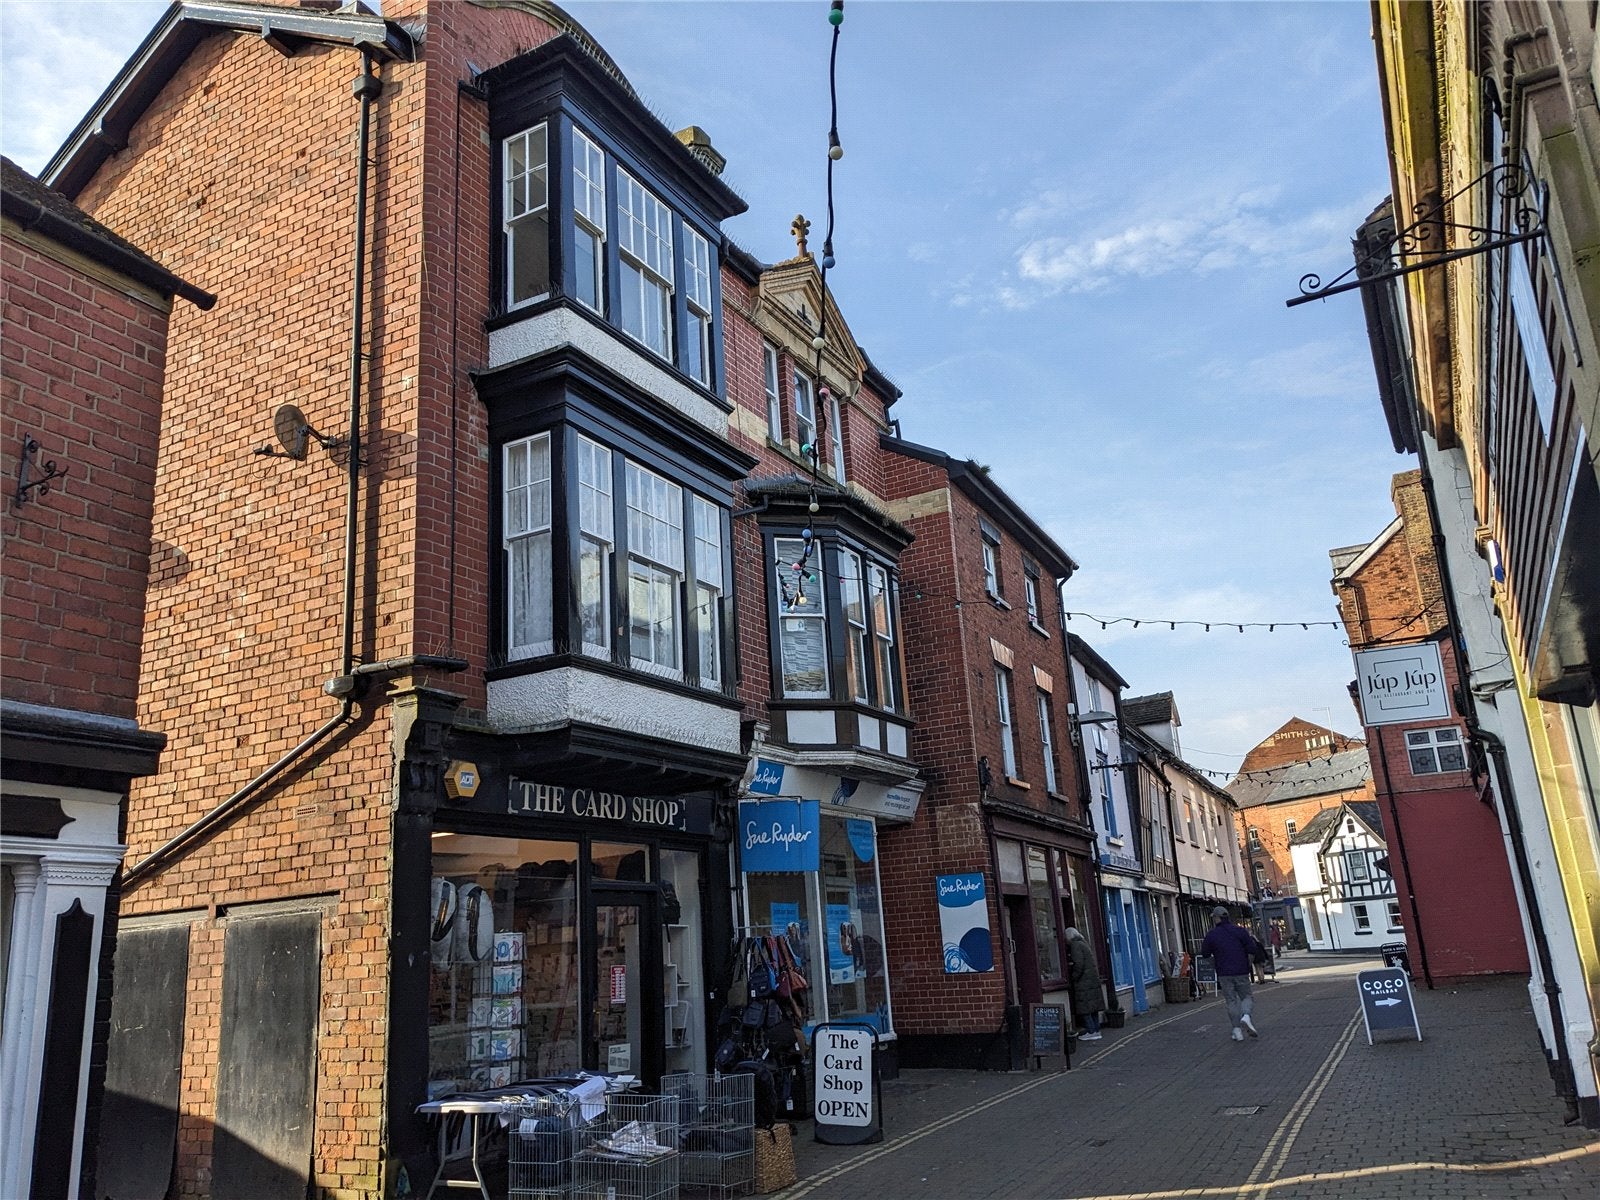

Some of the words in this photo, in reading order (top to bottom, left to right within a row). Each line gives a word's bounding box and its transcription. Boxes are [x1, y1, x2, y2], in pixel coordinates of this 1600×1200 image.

[1367, 674, 1399, 695] Júp
[1404, 669, 1437, 691] Júp
[1274, 731, 1303, 741] SMITH
[1303, 729, 1310, 737] &
[460, 774, 475, 785] ADT
[761, 767, 780, 790] Ryder
[519, 781, 566, 814] THE
[571, 788, 627, 820] CARD
[632, 796, 679, 826] SHOP
[745, 820, 771, 850] Sue
[771, 822, 812, 852] Ryder
[939, 878, 956, 897] Sue
[956, 878, 981, 897] Ryder
[1363, 978, 1404, 991] COCO
[828, 1033, 859, 1050] The
[823, 1054, 863, 1071] Card
[823, 1074, 863, 1095] Shop
[817, 1100, 869, 1118] OPEN
